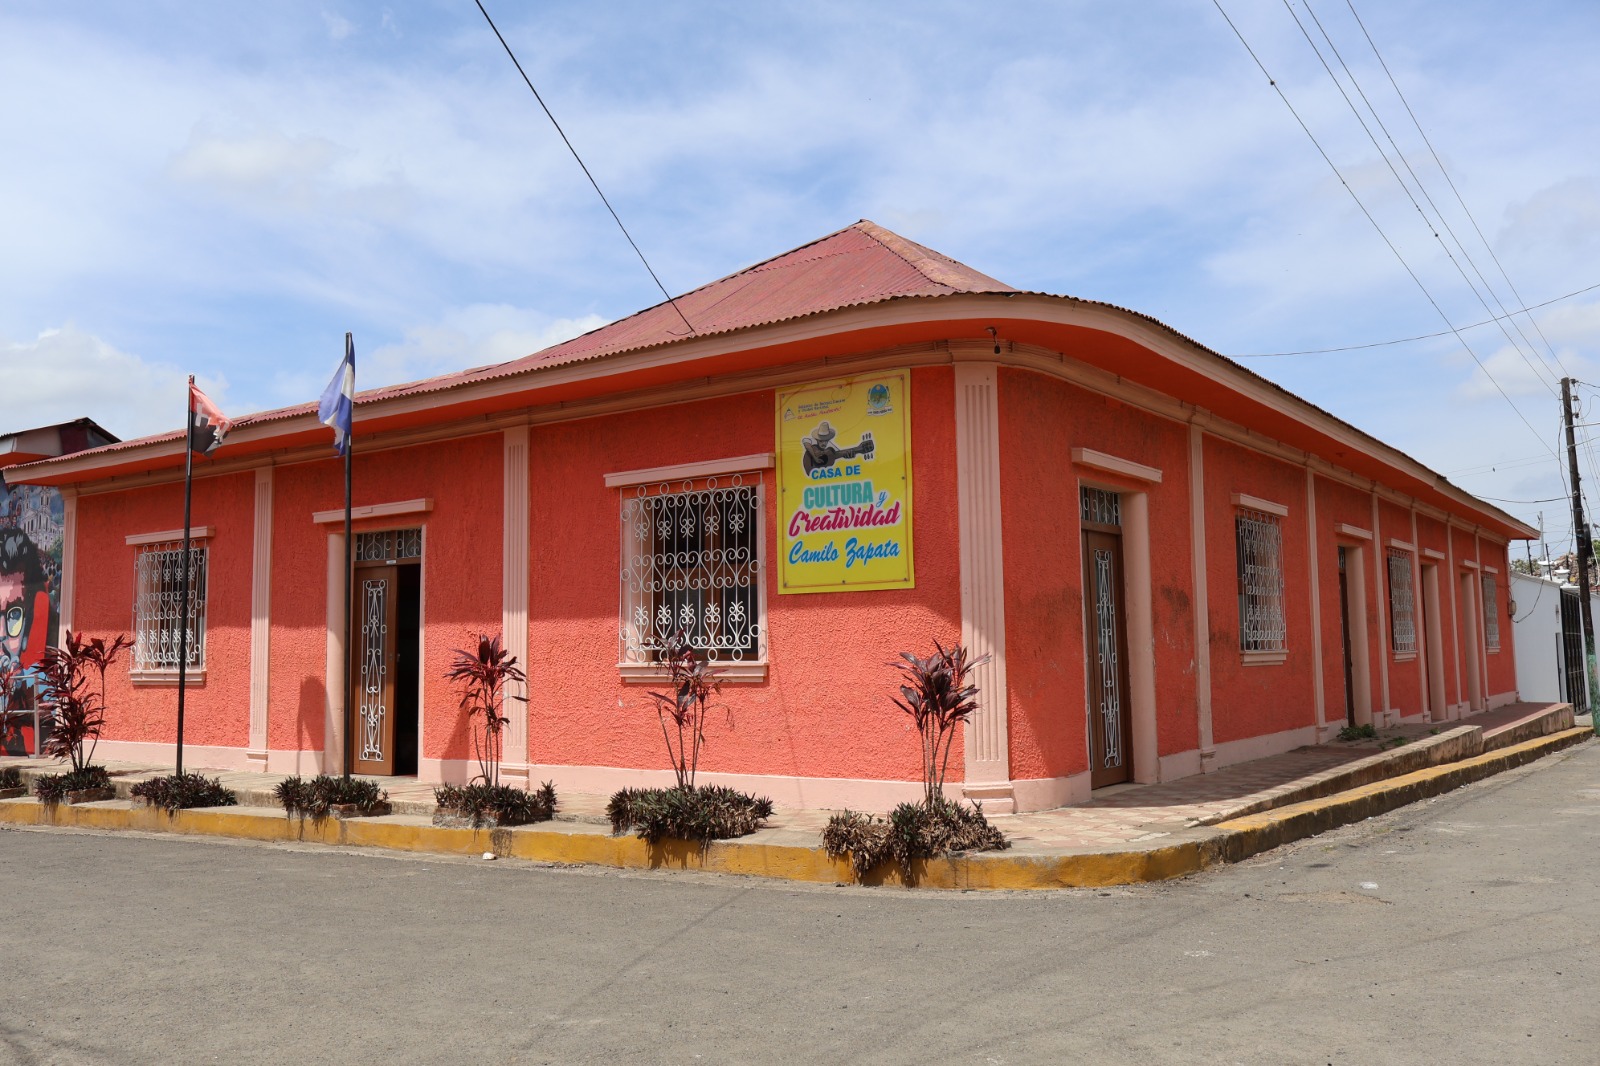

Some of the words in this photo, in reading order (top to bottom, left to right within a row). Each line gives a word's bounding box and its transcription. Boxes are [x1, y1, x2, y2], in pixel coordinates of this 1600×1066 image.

[811, 467, 842, 480] CASA
[845, 464, 861, 477] DE
[803, 481, 873, 510] CULTURA
[876, 491, 887, 508] y
[788, 501, 901, 537] Creatividad
[788, 540, 840, 565] Camilo
[844, 537, 900, 568] Zapata
